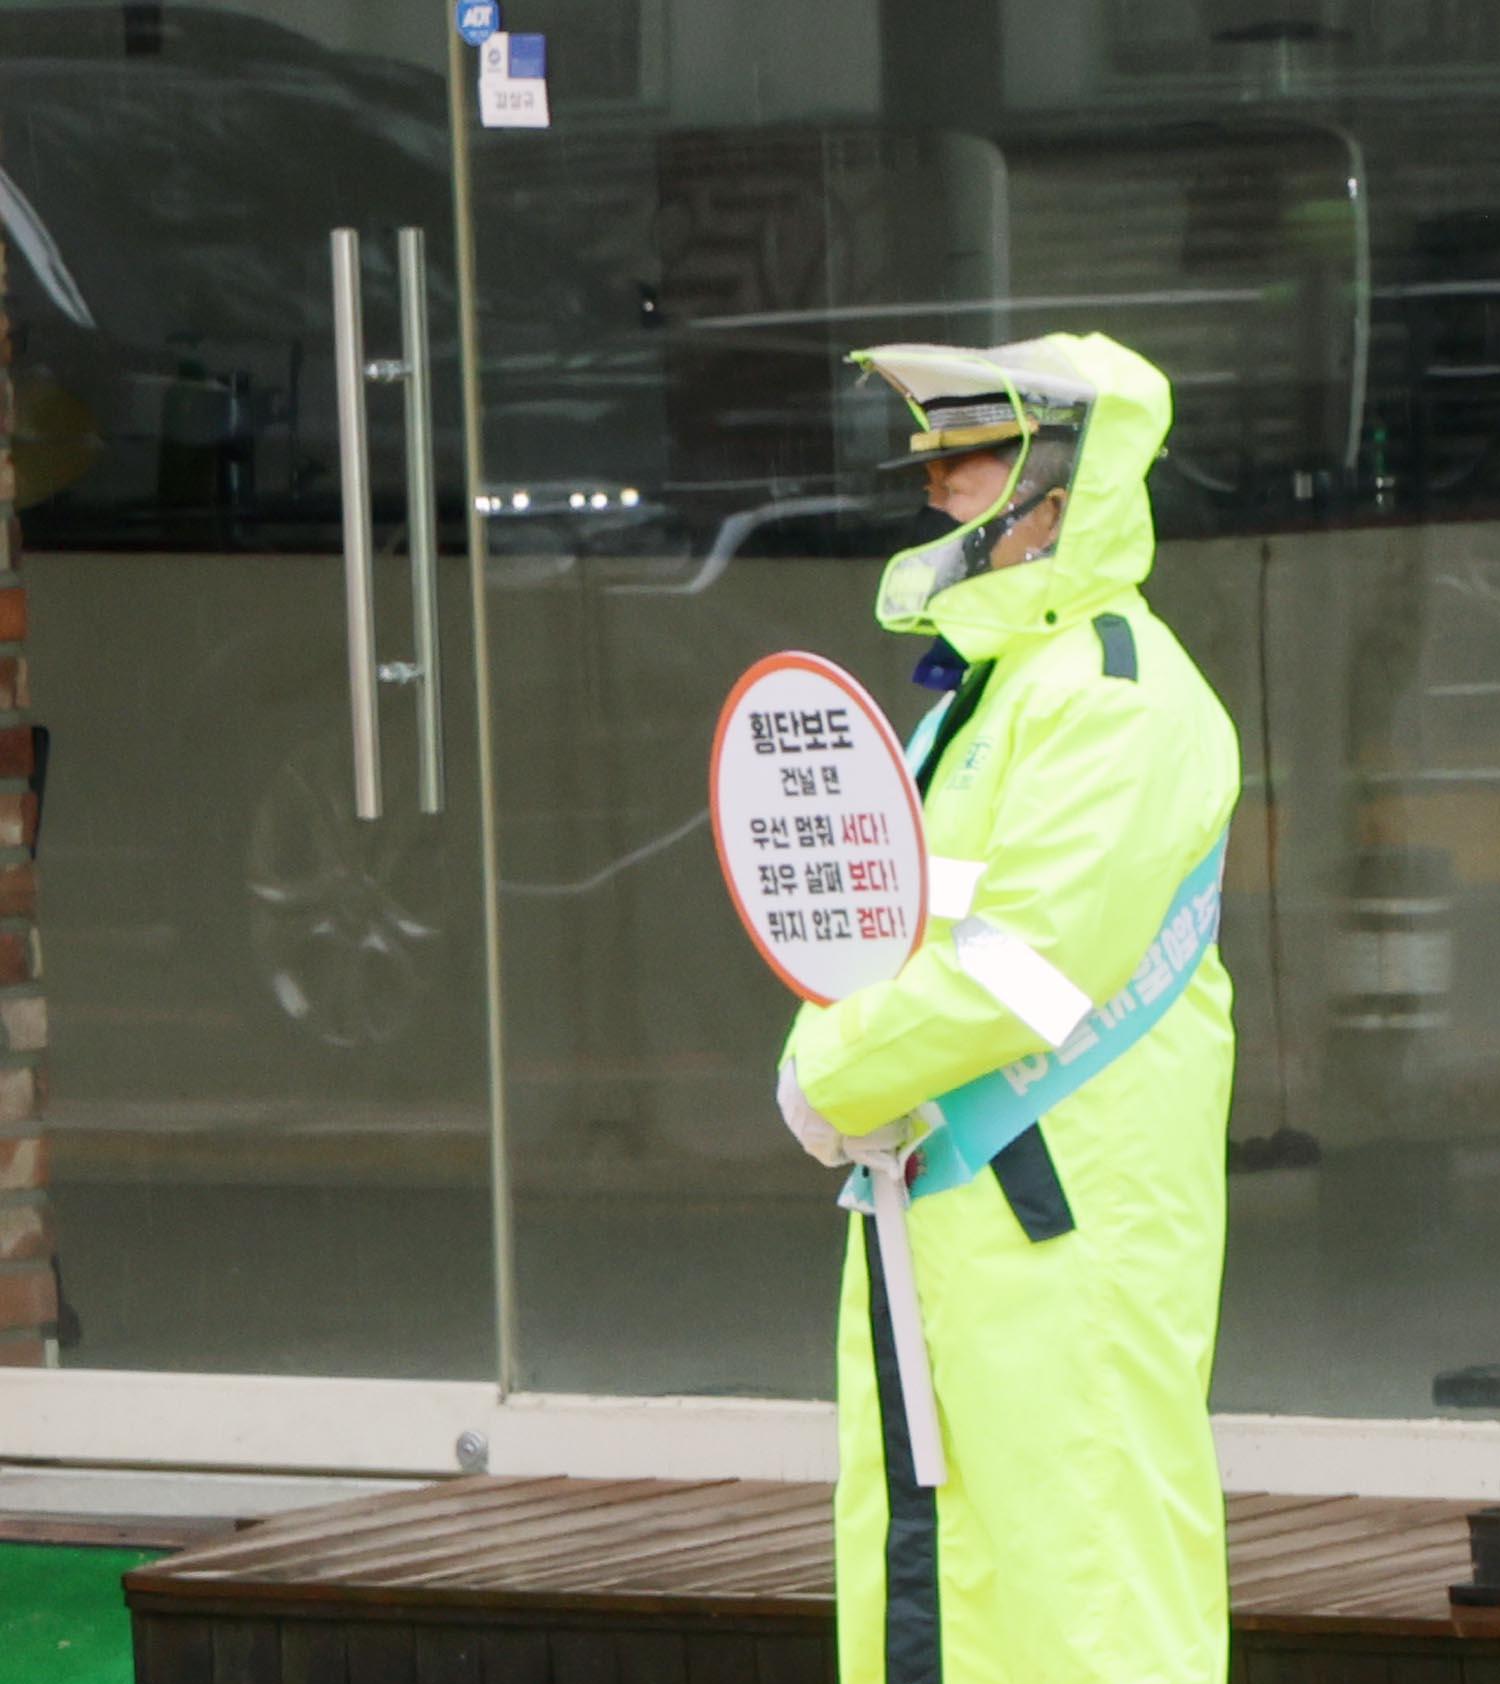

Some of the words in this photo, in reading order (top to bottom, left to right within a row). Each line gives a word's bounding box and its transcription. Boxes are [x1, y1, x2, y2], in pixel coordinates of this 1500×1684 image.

[749, 708, 854, 755] 횡단보도
[780, 765, 817, 797] 건널
[750, 815, 790, 850] 우선
[794, 813, 835, 848] 멈춰
[841, 811, 890, 846] 서다!
[757, 863, 798, 896] 좌우
[804, 859, 844, 895] 살펴
[849, 858, 899, 893] 보다!
[766, 908, 808, 943] 뛰지
[811, 908, 852, 942] 않고
[856, 905, 907, 940] 걷다!
